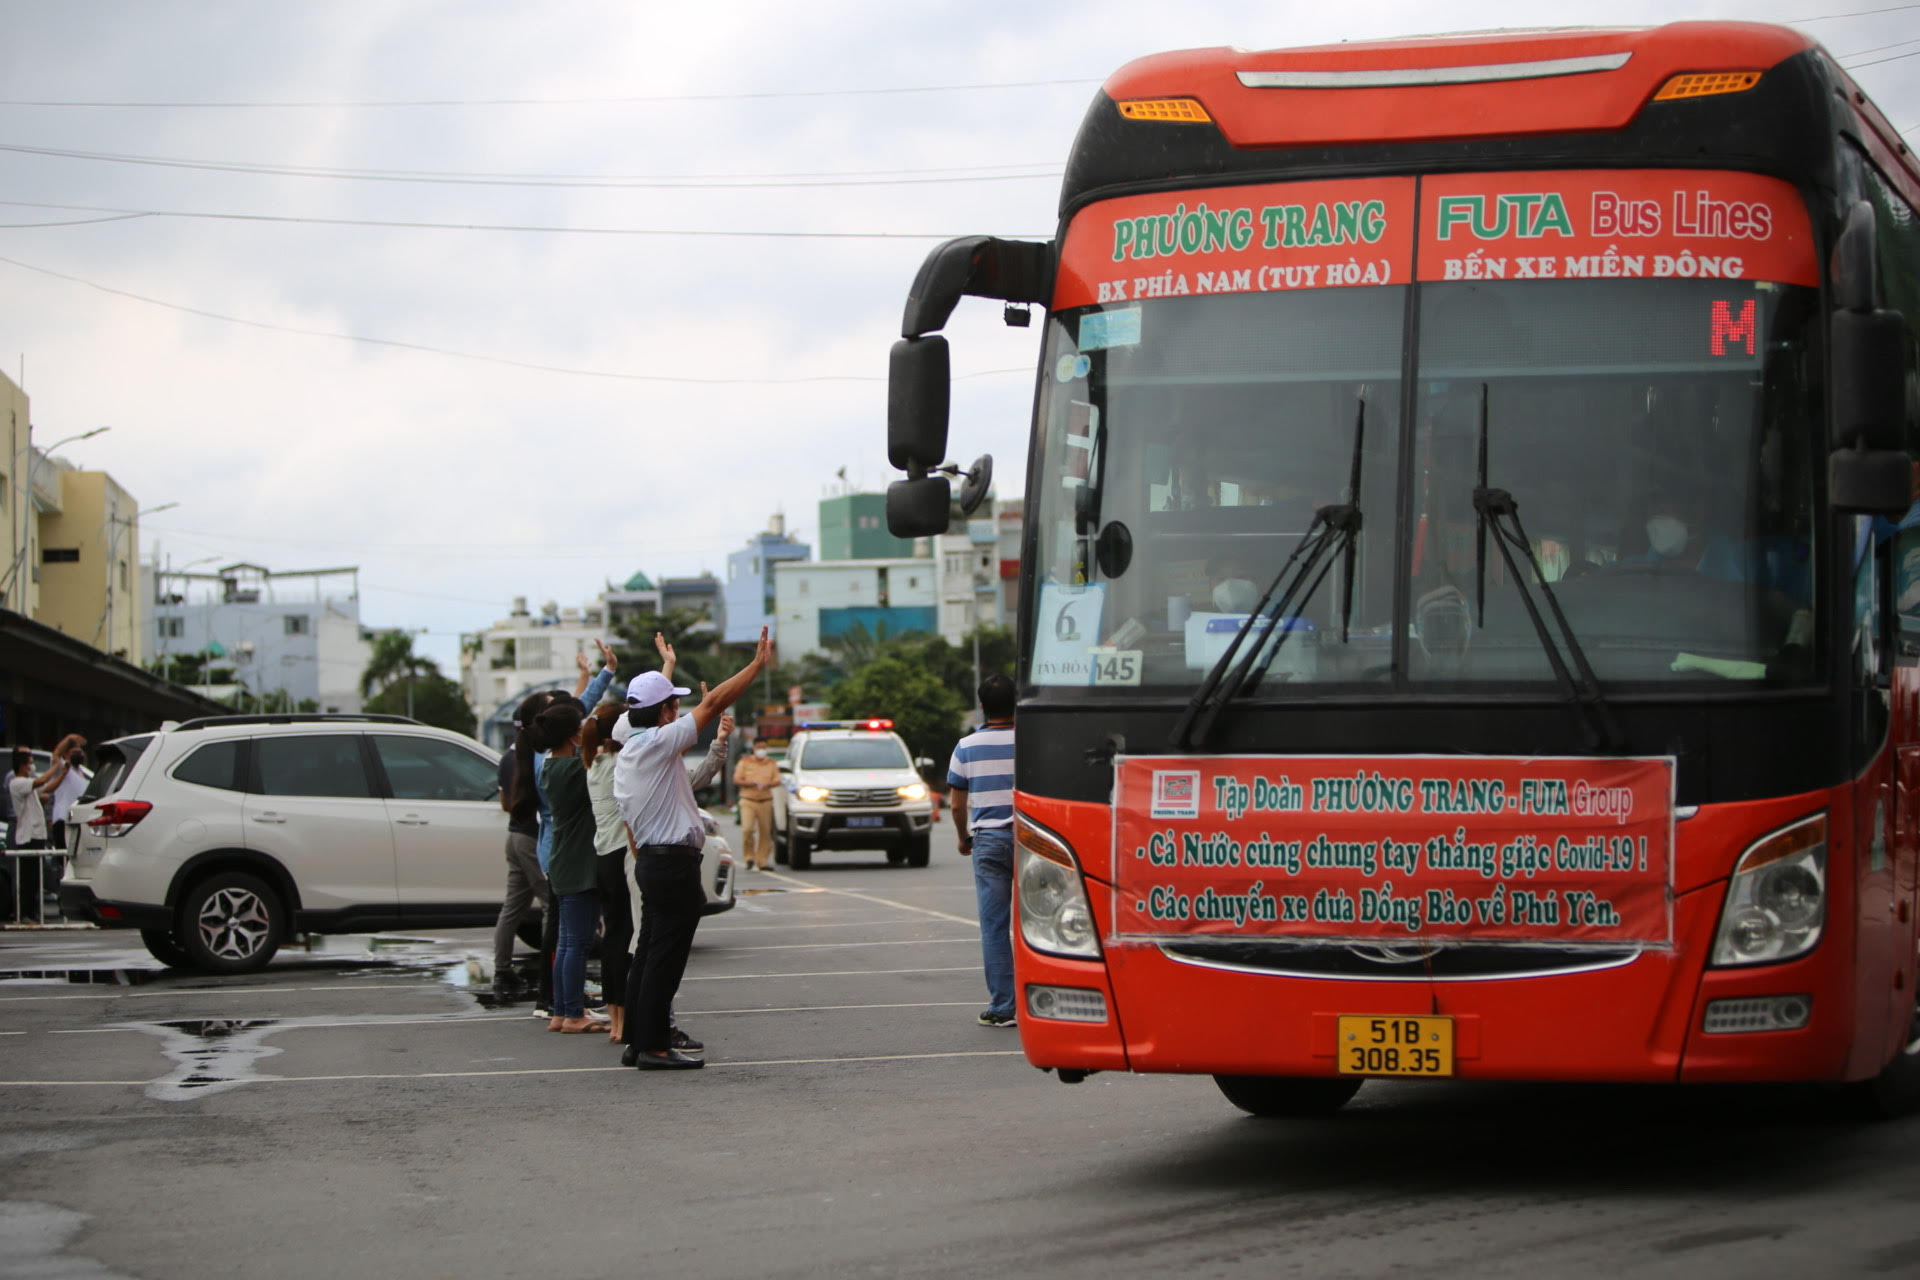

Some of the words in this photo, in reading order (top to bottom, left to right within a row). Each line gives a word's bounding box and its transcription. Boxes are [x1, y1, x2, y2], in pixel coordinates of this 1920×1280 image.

[1112, 203, 1253, 262] PHƯƠNG
[1261, 200, 1387, 249] TRANG
[1437, 192, 1574, 241] FUTA
[1591, 191, 1661, 237] Bus
[1673, 191, 1772, 240] Lines
[1098, 280, 1127, 303] BX
[1134, 269, 1189, 297] PHÍA
[1196, 270, 1251, 294] NAM
[1258, 265, 1323, 291] (TUY
[1326, 257, 1391, 286] HÒA)
[1443, 248, 1507, 280] BẾN
[1514, 257, 1556, 278] XE
[1564, 245, 1645, 278] MIỀN
[1653, 249, 1744, 279] ĐÔNG
[1055, 600, 1079, 641] 6
[1213, 776, 1249, 820] Tập
[1253, 775, 1302, 812] Đoàn
[1311, 769, 1413, 812] PHƯƠNG
[1420, 779, 1504, 813] TRANG
[1519, 779, 1569, 814] FUTA
[1573, 780, 1633, 824] Group
[1149, 828, 1177, 867] Cả
[1182, 831, 1241, 867] Nước
[1246, 831, 1301, 876] cùng
[1306, 833, 1377, 877] chung
[1382, 836, 1421, 876] tay
[1426, 826, 1496, 878] thắng
[1502, 836, 1551, 878] giặc
[1149, 885, 1190, 920] Các
[1194, 880, 1277, 927] chuyến
[1281, 895, 1308, 921] xe
[1313, 888, 1354, 922] đưa
[1360, 881, 1421, 932] Đồng
[1426, 889, 1472, 924] Bào
[1477, 882, 1505, 925] về
[1510, 890, 1559, 925] Phú
[1564, 890, 1621, 926] Yên.
[1371, 1020, 1419, 1044] 51B
[1351, 1047, 1440, 1072] 308.35
